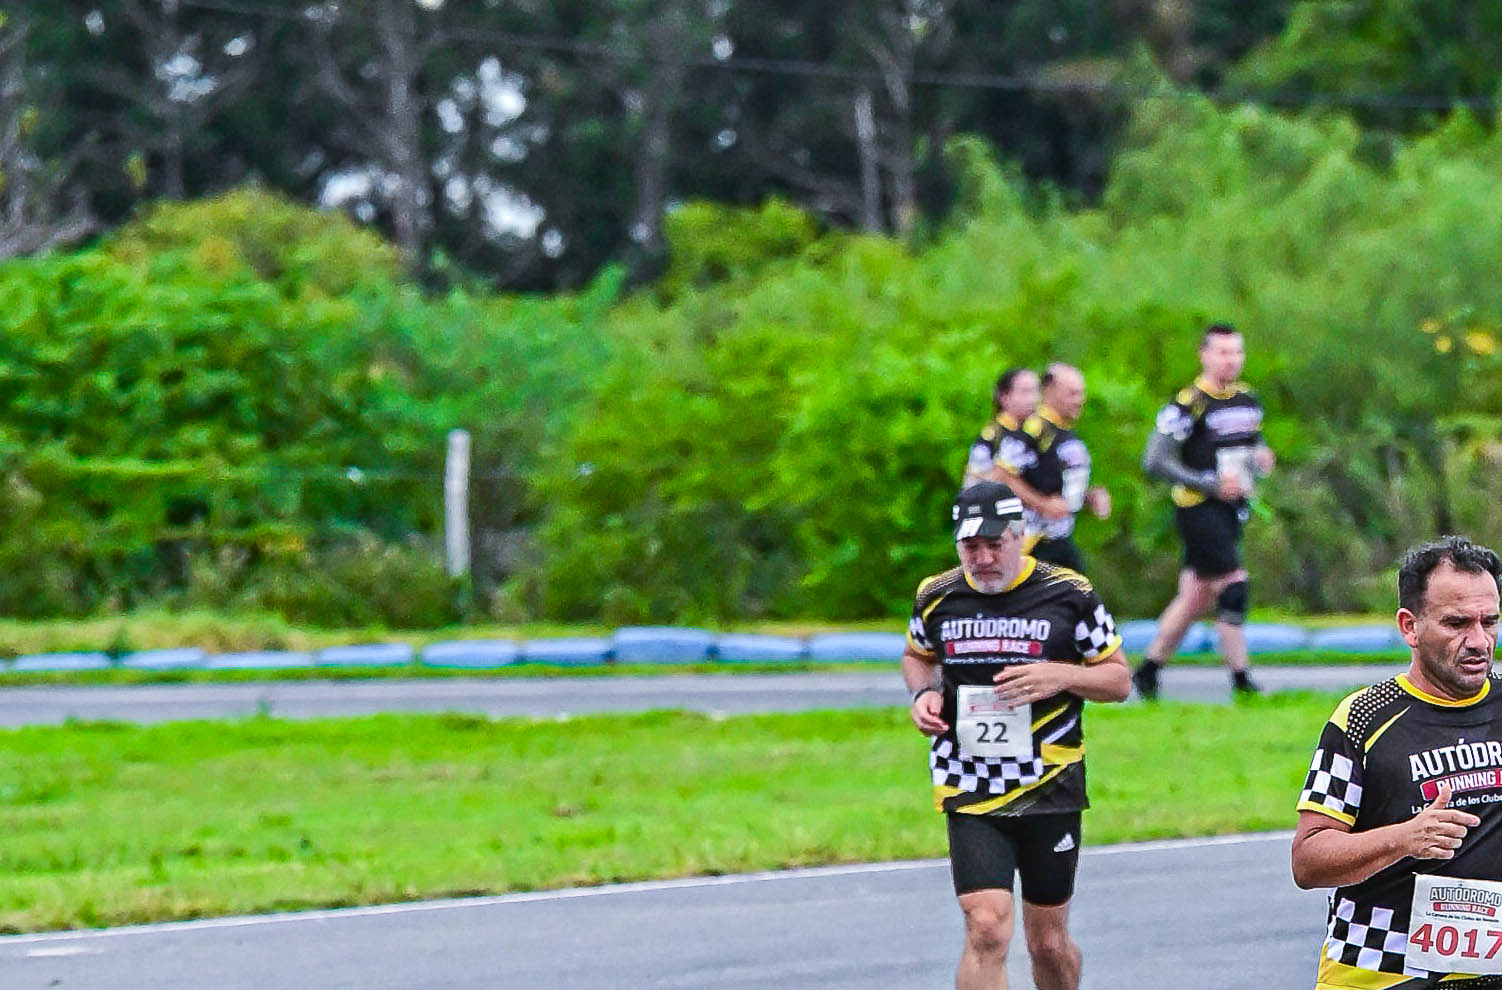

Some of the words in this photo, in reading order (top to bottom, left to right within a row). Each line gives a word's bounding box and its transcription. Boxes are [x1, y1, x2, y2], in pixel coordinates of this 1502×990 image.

[941, 613, 1051, 641] AUTÓDROMO
[976, 722, 1009, 743] 22
[1437, 771, 1497, 793] RUNNING
[1455, 798, 1467, 807] de
[1468, 796, 1480, 804] los
[1430, 883, 1502, 907] AUTÓDROMO
